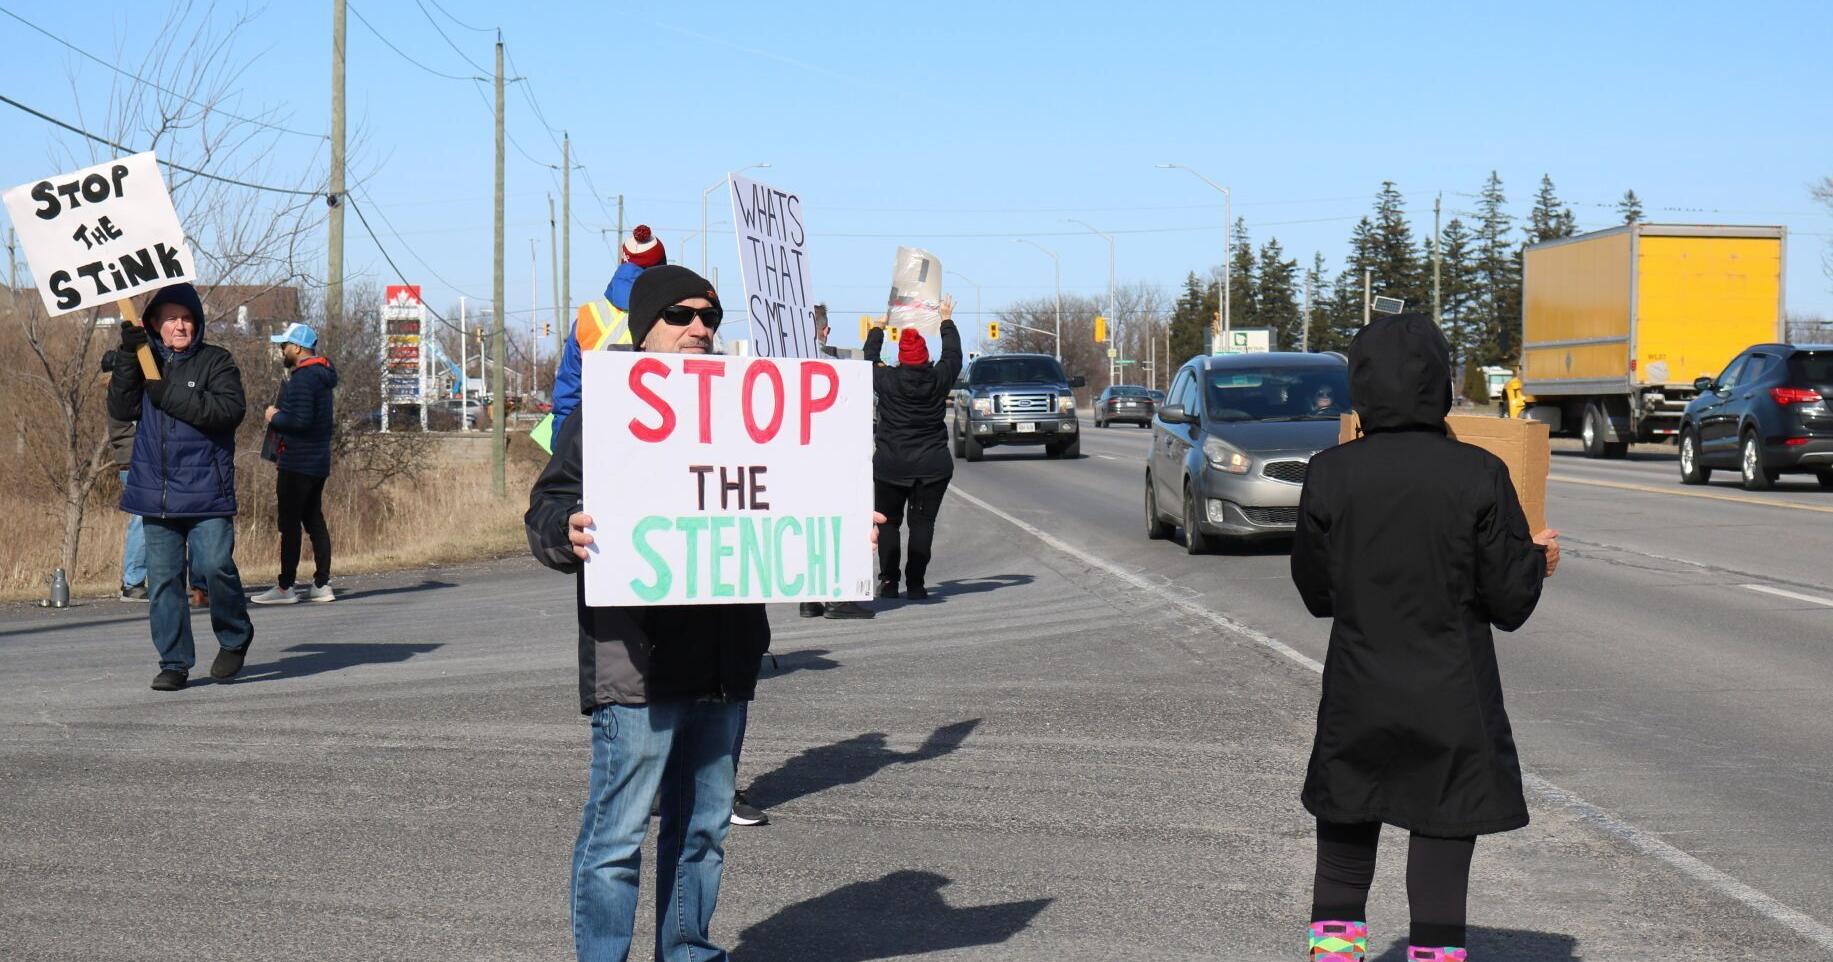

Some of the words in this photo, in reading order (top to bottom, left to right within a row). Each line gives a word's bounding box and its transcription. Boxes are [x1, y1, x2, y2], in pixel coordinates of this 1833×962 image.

[31, 164, 129, 220] STOP
[733, 180, 805, 247] WHATS
[72, 215, 123, 250] THE
[747, 235, 803, 307] THAT
[628, 357, 840, 446] STOP
[689, 465, 770, 511] THE
[629, 515, 842, 602] STENCH!
